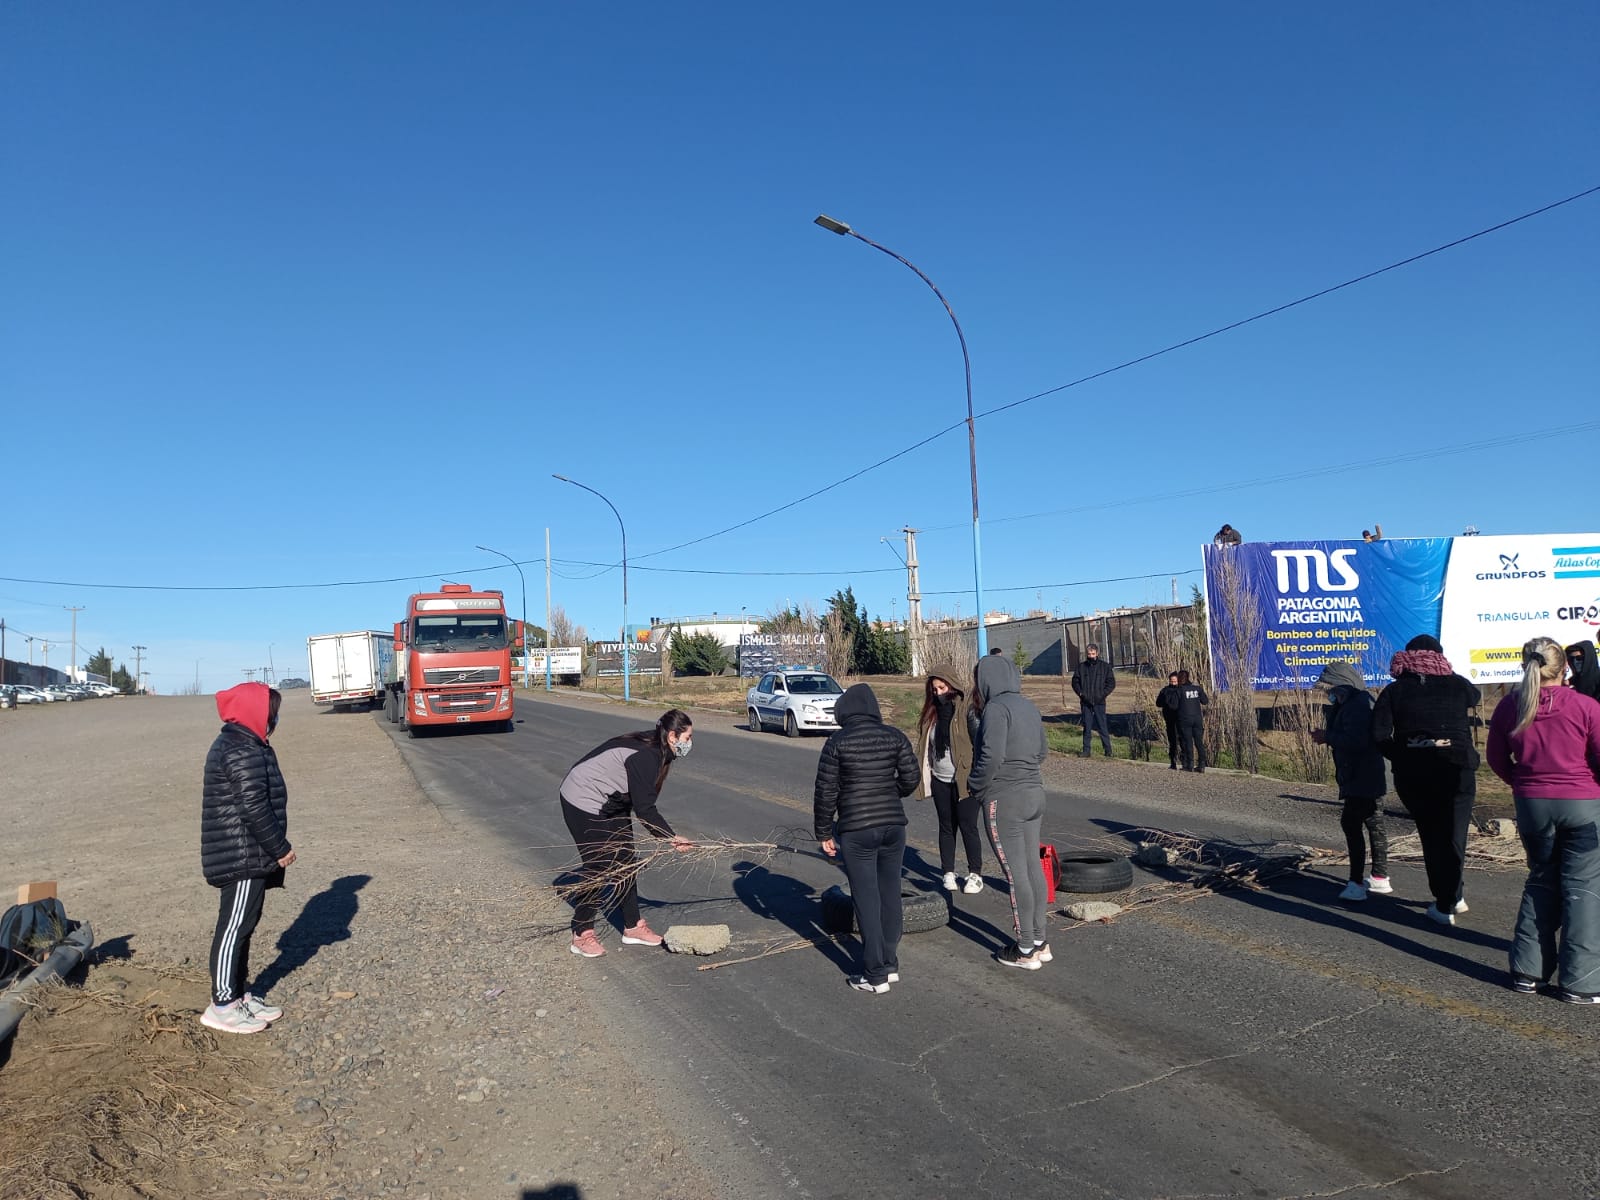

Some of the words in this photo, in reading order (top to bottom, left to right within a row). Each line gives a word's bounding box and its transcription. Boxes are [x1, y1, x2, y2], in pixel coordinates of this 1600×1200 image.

[1553, 557, 1584, 568] Atlas
[1475, 570, 1546, 580] GRUNDFOS
[1277, 596, 1361, 610] PATAGONIA
[1278, 610, 1363, 624] ARGENTINA
[741, 634, 777, 646] ISMAEL
[781, 634, 826, 645] MACHCA
[1266, 630, 1313, 639] Bombeo
[1315, 629, 1329, 638] de
[1331, 628, 1376, 640] líquidos
[1276, 643, 1298, 653] Aire
[1300, 641, 1369, 654] comprimido
